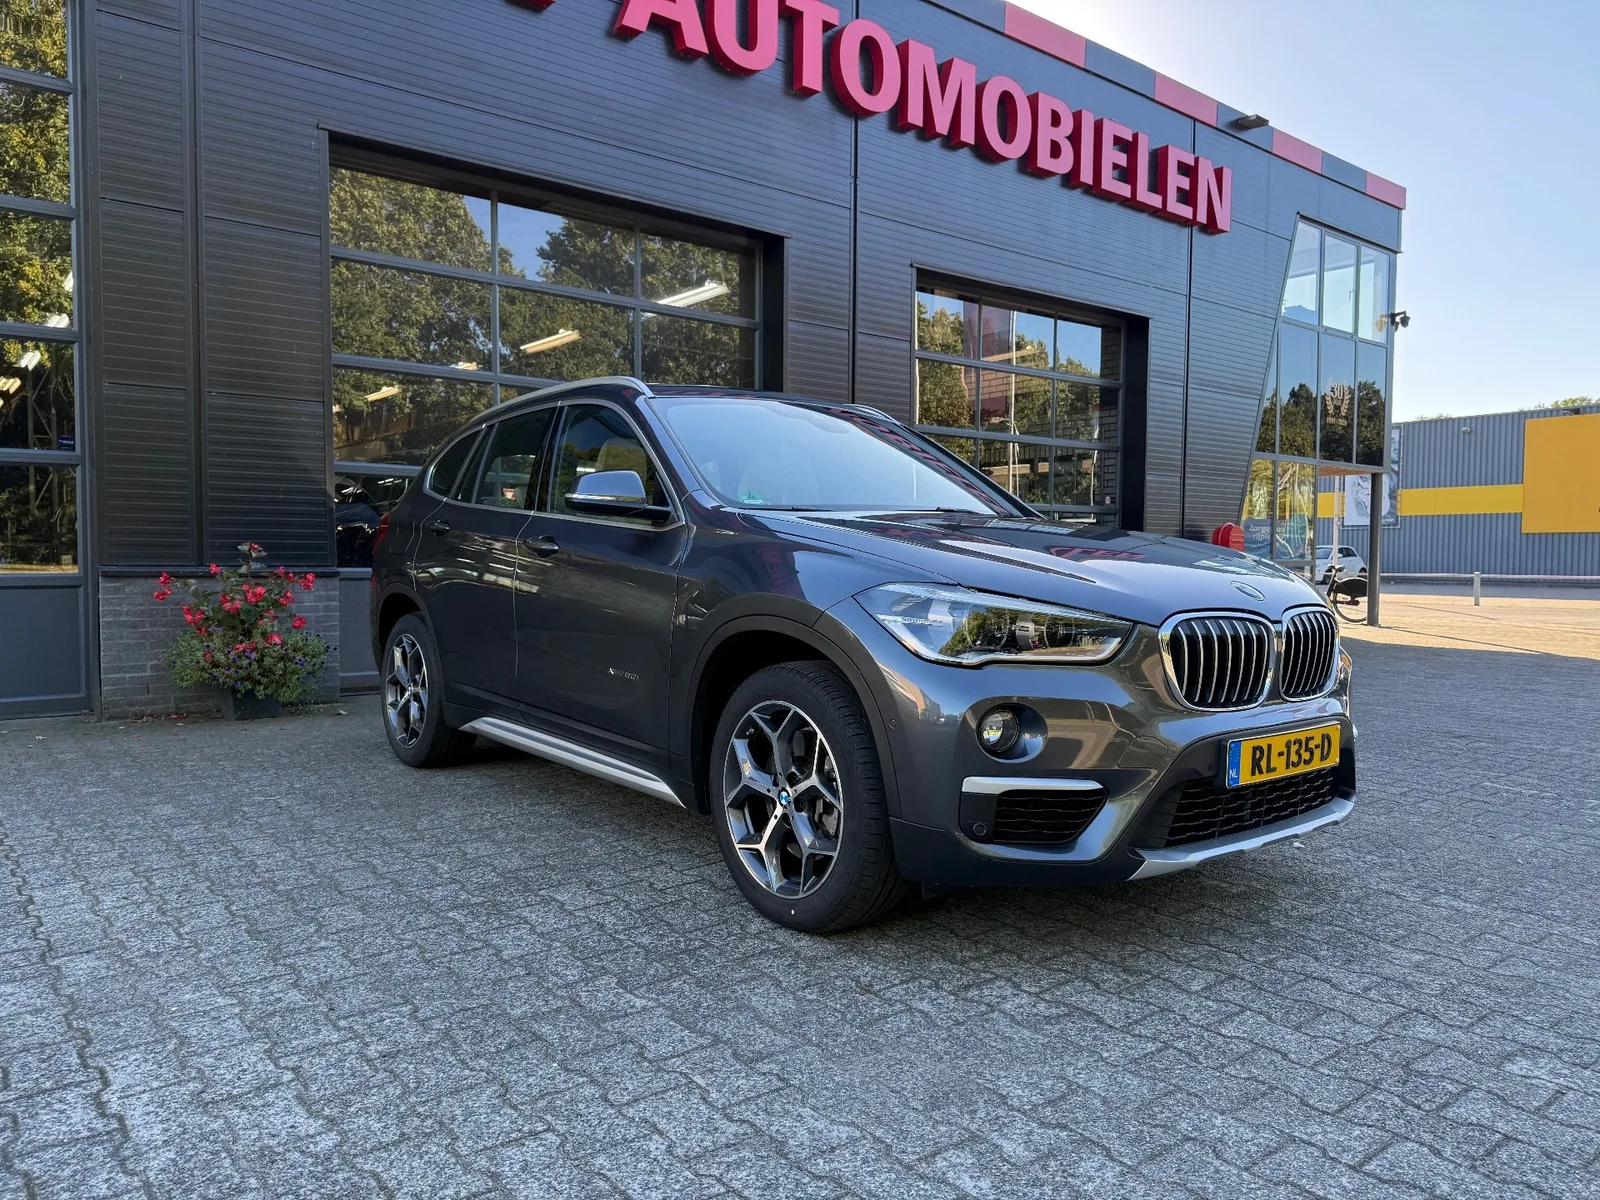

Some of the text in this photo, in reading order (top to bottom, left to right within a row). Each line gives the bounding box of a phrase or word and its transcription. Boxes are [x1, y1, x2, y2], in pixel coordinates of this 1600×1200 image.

[1331, 383, 1343, 399] 30
[1251, 733, 1333, 776] RL-135-D
[1229, 768, 1238, 779] NL
